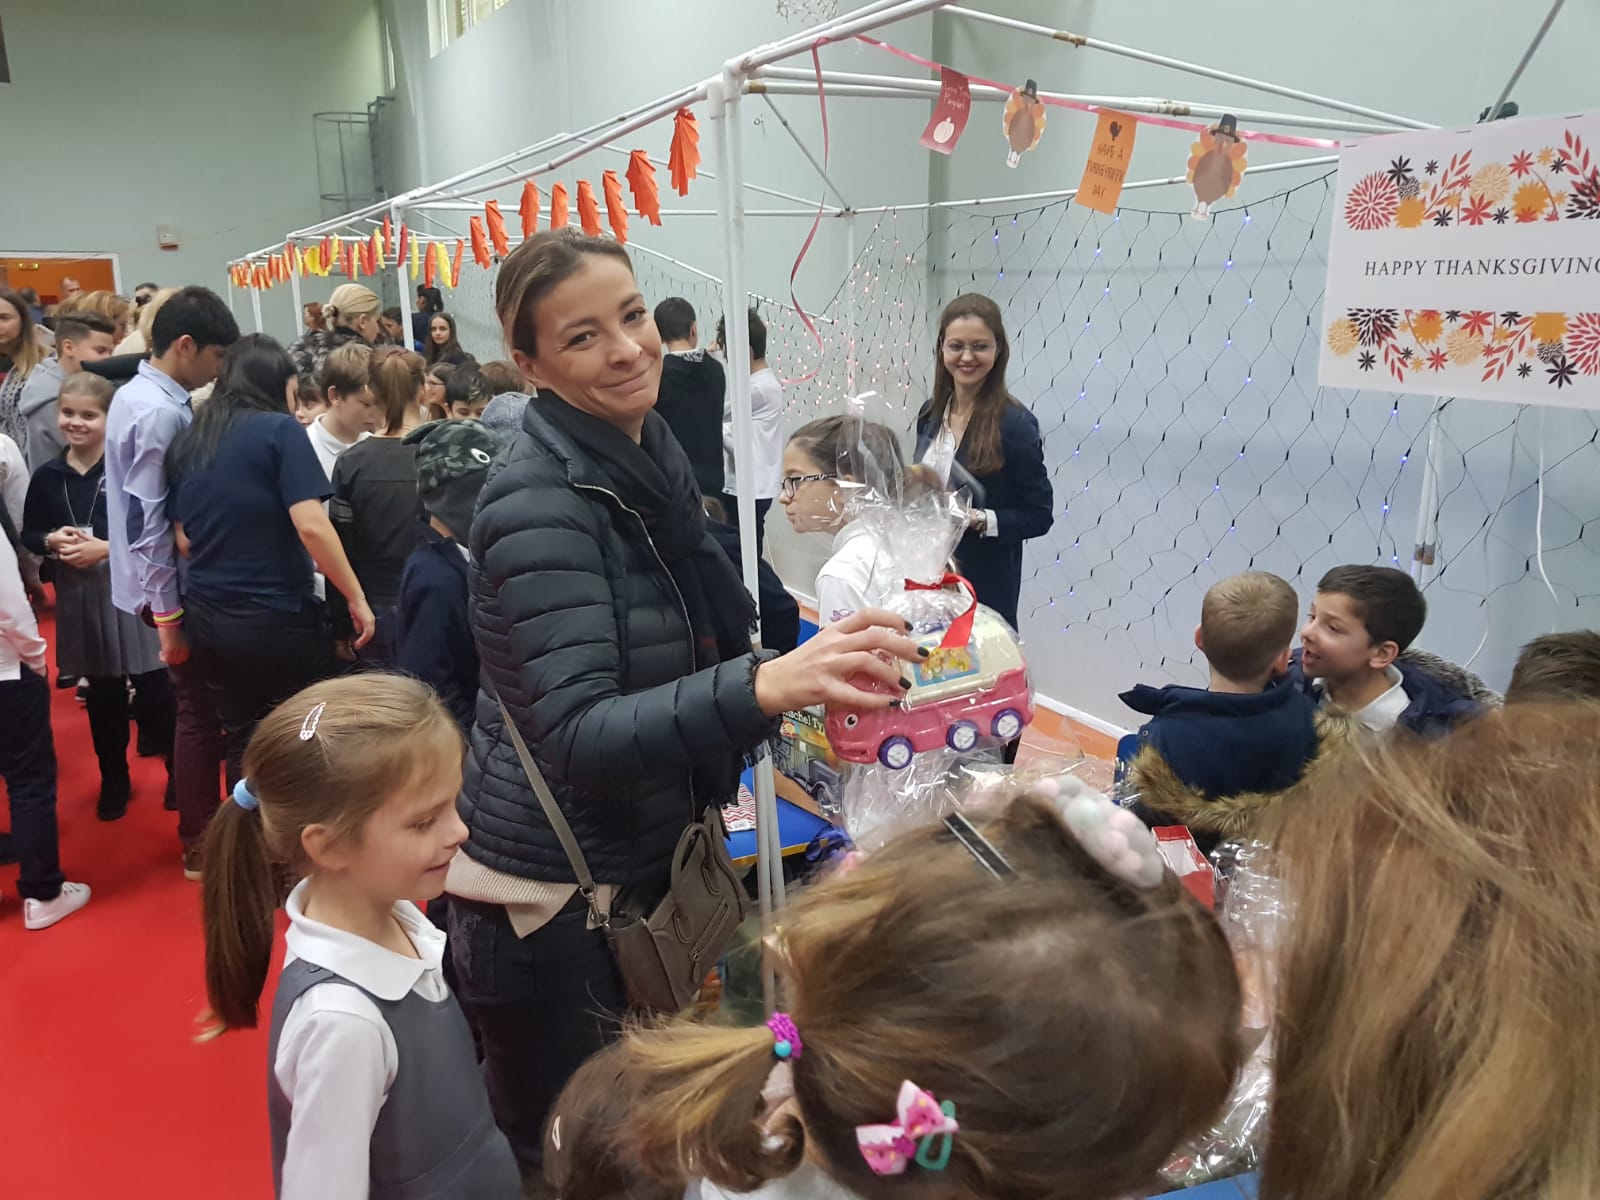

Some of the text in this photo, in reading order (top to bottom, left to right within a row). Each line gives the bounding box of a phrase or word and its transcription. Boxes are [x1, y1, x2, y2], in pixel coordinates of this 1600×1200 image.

[1097, 143, 1124, 160] HAVE A
[1092, 183, 1106, 198] DAY
[1364, 260, 1428, 276] HAPPY
